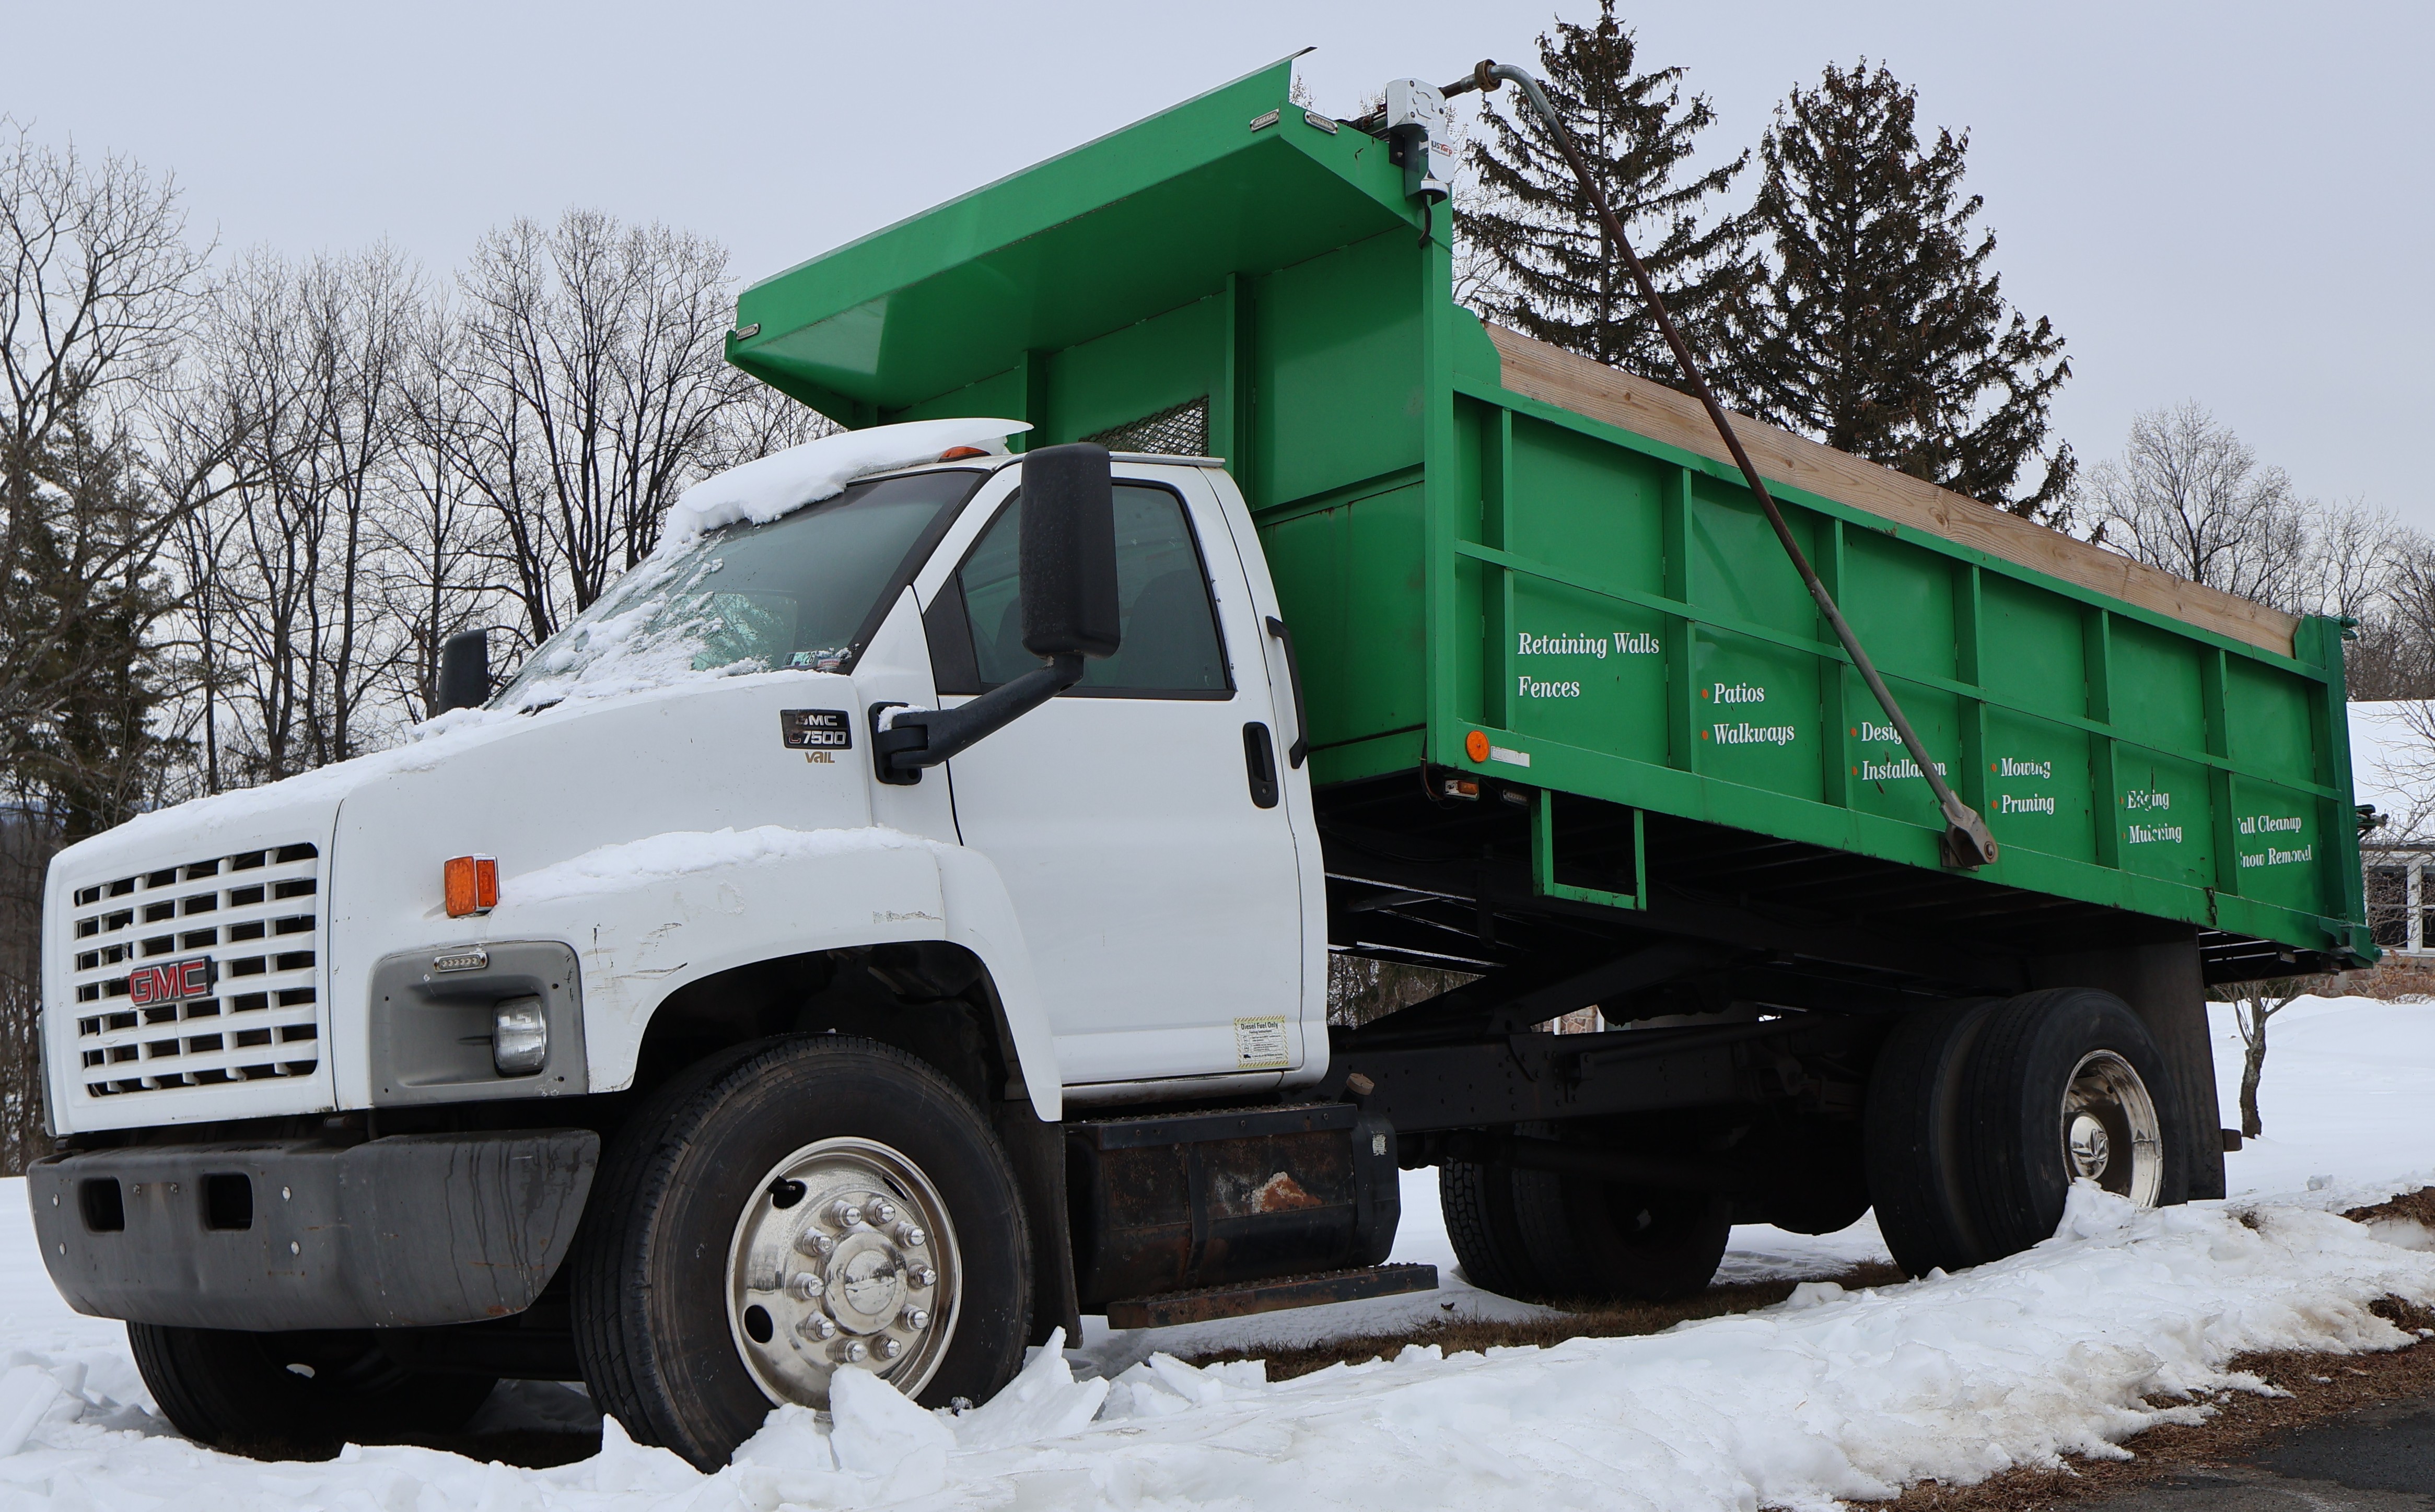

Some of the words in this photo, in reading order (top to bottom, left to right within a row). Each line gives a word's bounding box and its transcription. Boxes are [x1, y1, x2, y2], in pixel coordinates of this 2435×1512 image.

[1518, 632, 1607, 659] Retaining
[1613, 632, 1659, 653] Walls
[805, 652, 815, 664] 26
[1518, 676, 1580, 697] Fences
[1714, 682, 1764, 704] Patios
[1714, 723, 1795, 746] Walkways
[1861, 721, 1902, 745] Desig
[1862, 759, 1947, 780] Installan
[2001, 757, 2050, 779] Mowing
[2001, 793, 2054, 815] Pruning
[2238, 816, 2256, 834] all
[2258, 815, 2301, 833] Cleanup
[2240, 851, 2265, 868] now
[130, 958, 207, 1005] GMC
